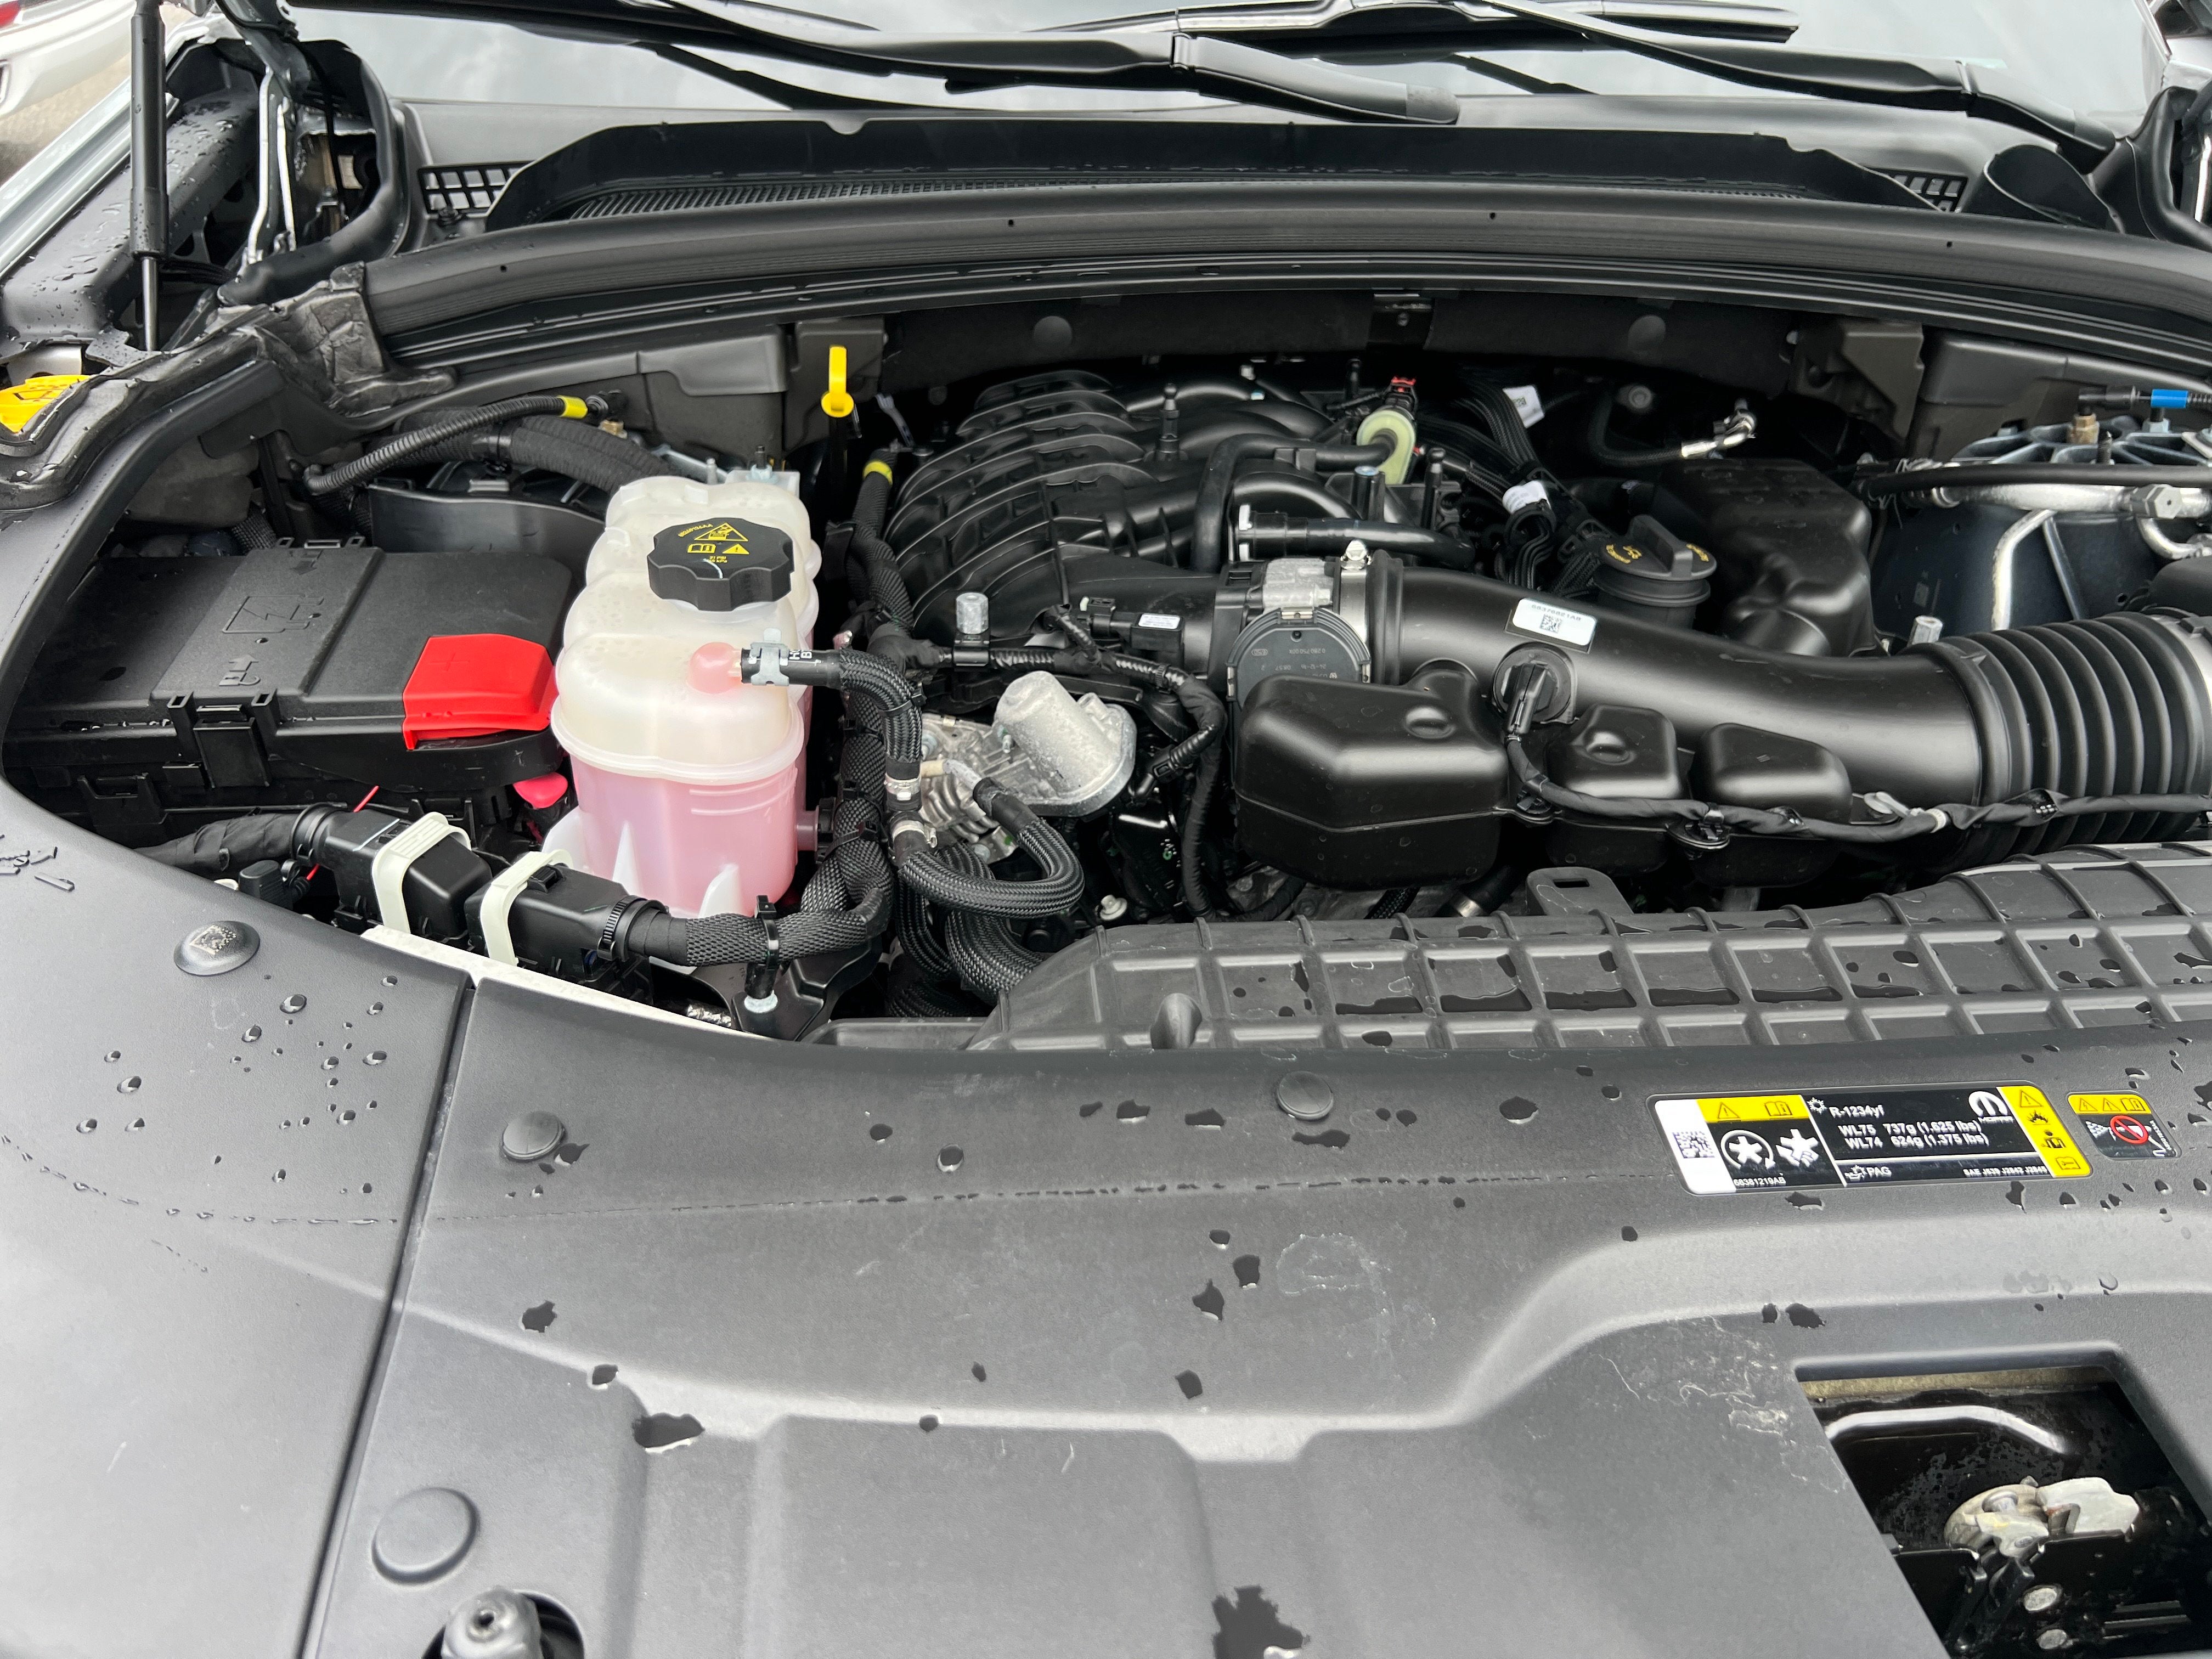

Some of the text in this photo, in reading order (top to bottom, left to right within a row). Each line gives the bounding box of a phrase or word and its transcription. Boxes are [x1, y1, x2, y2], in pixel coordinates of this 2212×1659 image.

[1829, 1105, 1884, 1119] R-1234yf
[1838, 1124, 1876, 1137] WL75
[1882, 1123, 1917, 1135] 737g
[1954, 1120, 1982, 1133] lbs)
[1844, 1136, 1883, 1150] WL74
[1891, 1135, 1924, 1149] 624g
[1962, 1132, 1989, 1147] lbs)
[1866, 1166, 1892, 1178] PAG
